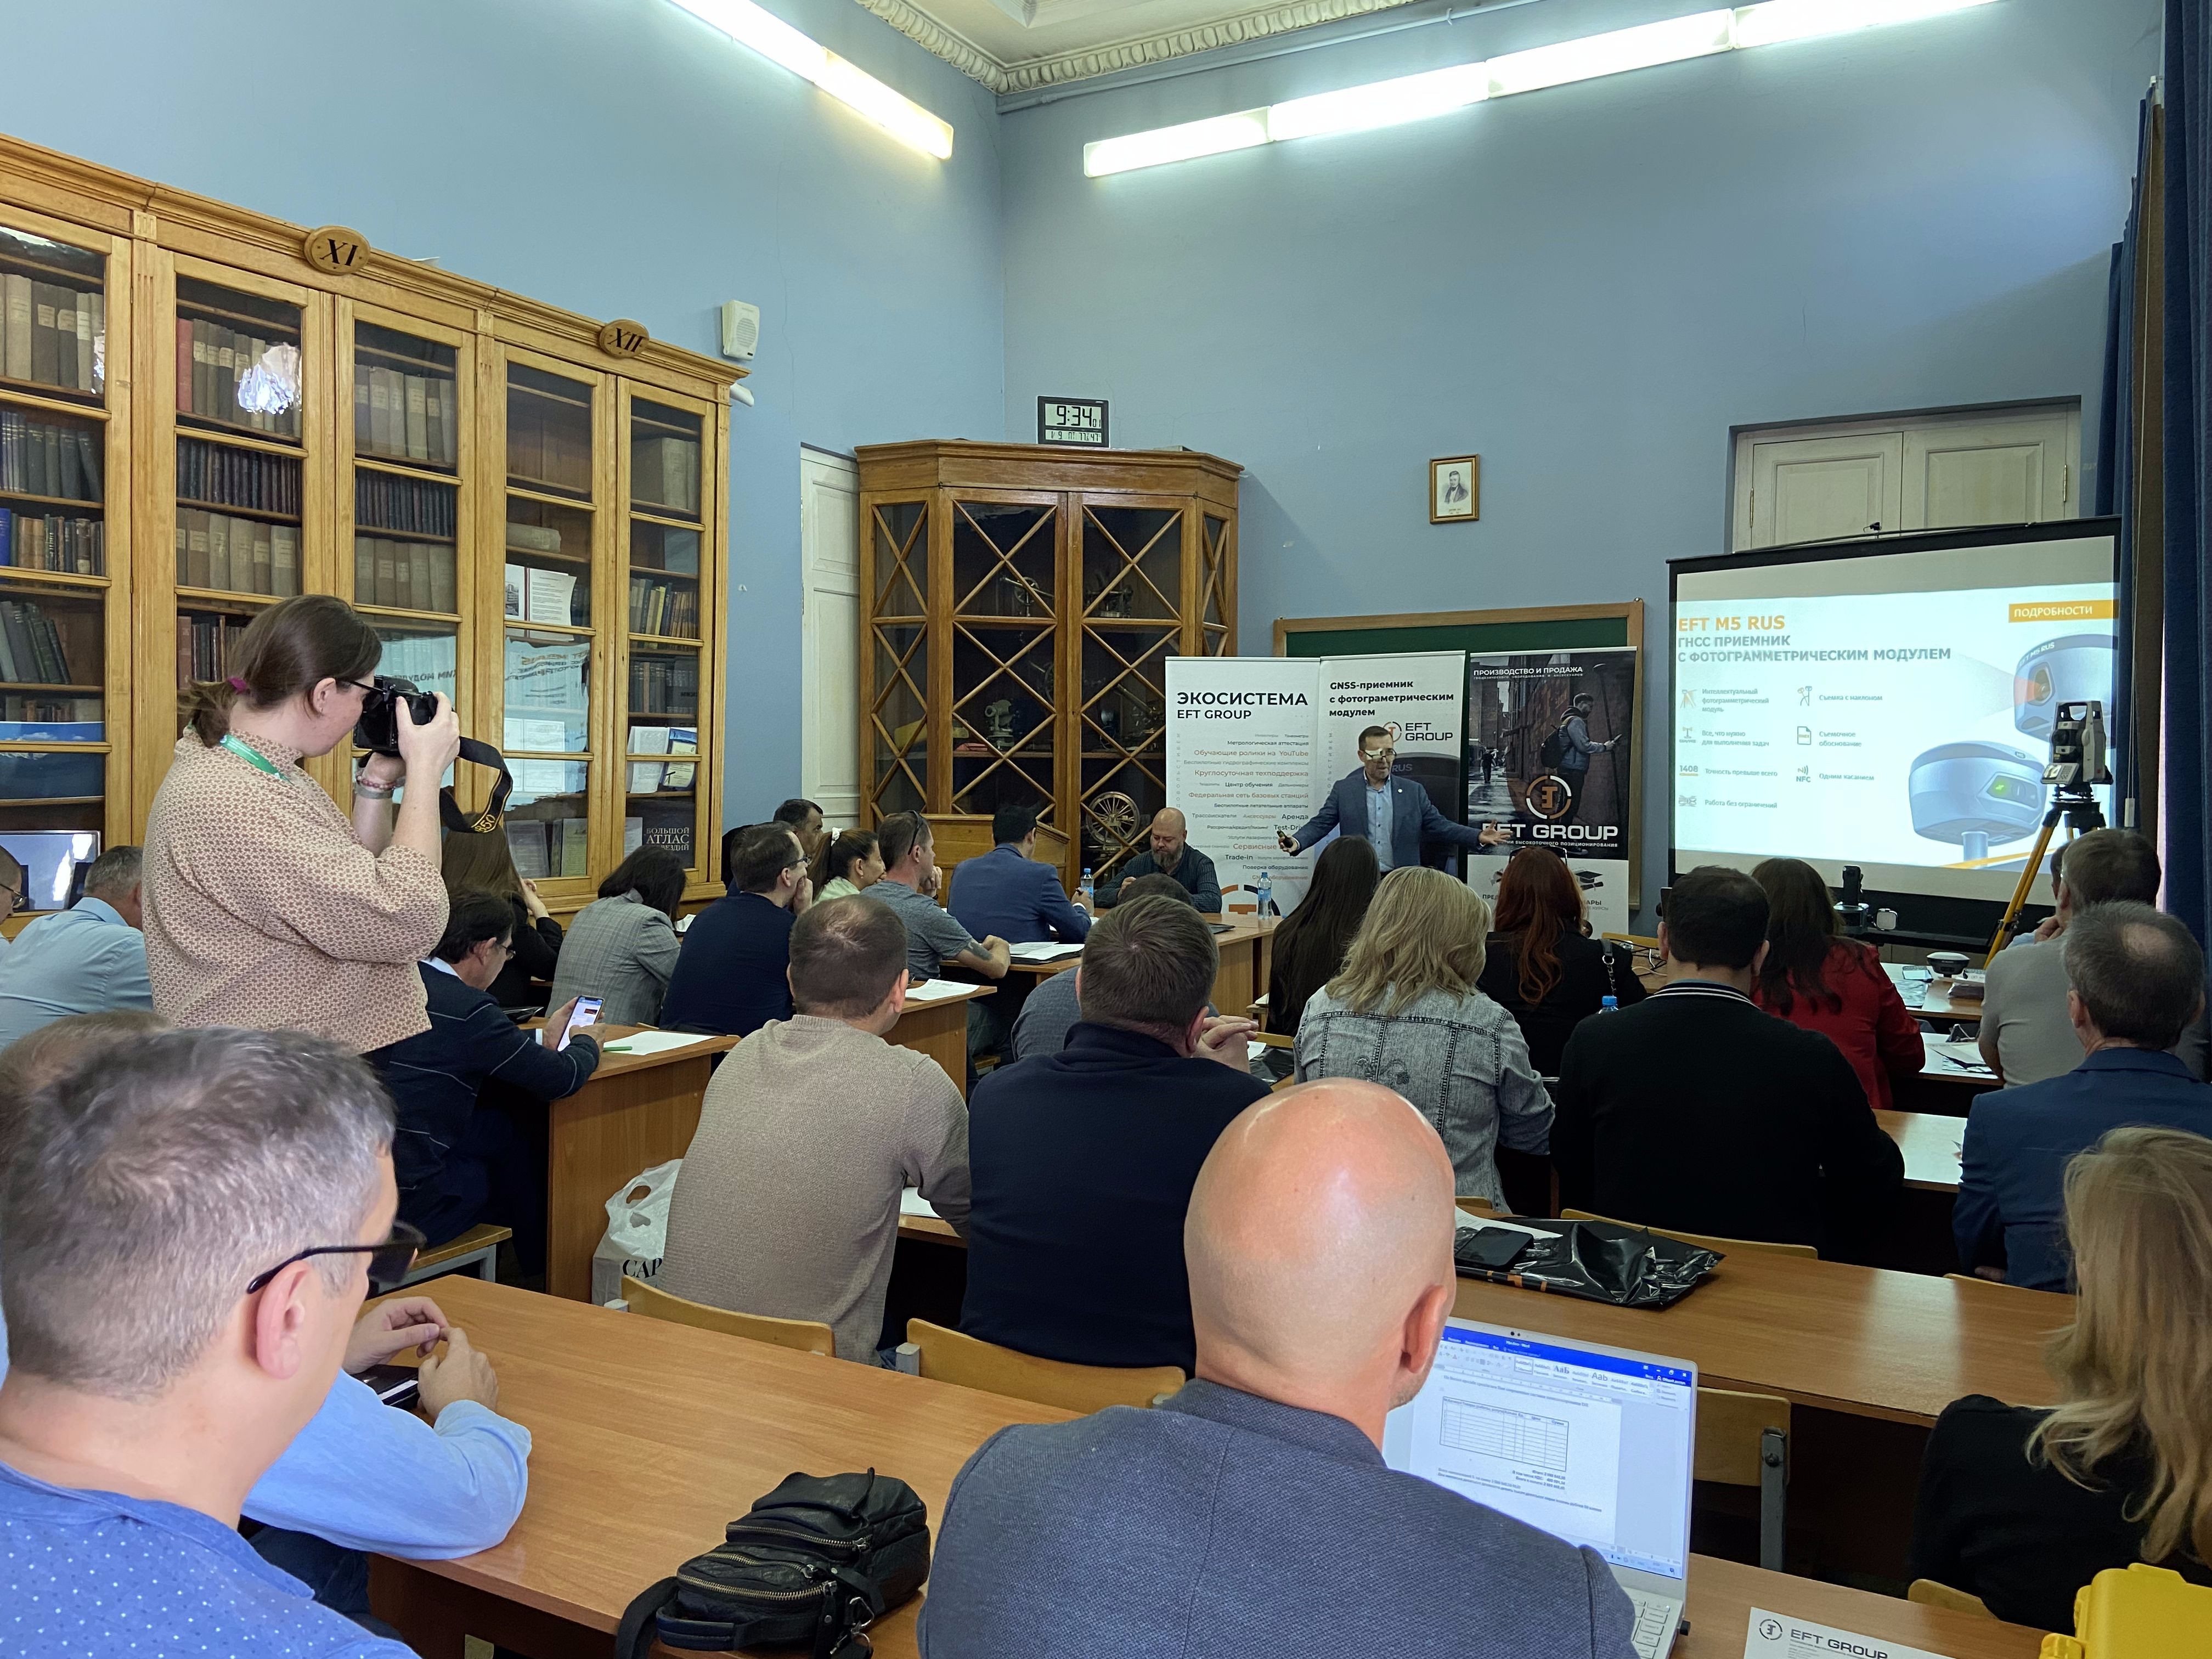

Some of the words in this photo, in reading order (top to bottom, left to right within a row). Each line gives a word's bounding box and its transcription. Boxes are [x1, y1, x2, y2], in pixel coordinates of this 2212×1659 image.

[319, 238, 359, 267] XI
[607, 327, 645, 353] XII
[1057, 405, 1092, 427] 9:34
[2014, 606, 2093, 618] ПОДРОБНОСТИ
[1678, 617, 1709, 631] EFT
[1716, 617, 1741, 631] M5
[1748, 615, 1785, 630] RUS
[1678, 637, 1711, 647] ГНСС
[1714, 635, 1791, 647] ПРИЕМНИК
[1678, 652, 1686, 662] С
[1689, 649, 1868, 662] ФОТОГРАММЕТРИЧЕСКИМ
[1874, 648, 1951, 662] МОДУЛЕМ
[1474, 668, 1534, 676] ПРОИЗВОДСТВО
[1330, 680, 1414, 690] GNSS-приемник
[1177, 692, 1308, 706] ЭКОСИСТЕМА
[1338, 693, 1454, 704] фотограметрическим
[1177, 709, 1200, 719] EFT
[1204, 709, 1251, 719] GROUP
[1329, 709, 1375, 718] модулем
[1405, 723, 1431, 731] EFT
[1405, 732, 1453, 741] GROUP
[1532, 825, 1618, 840] GROUP
[646, 834, 690, 844] АТЛАС
[1791, 1629, 1824, 1644] EFT
[1827, 1639, 1888, 1659] GROUP
